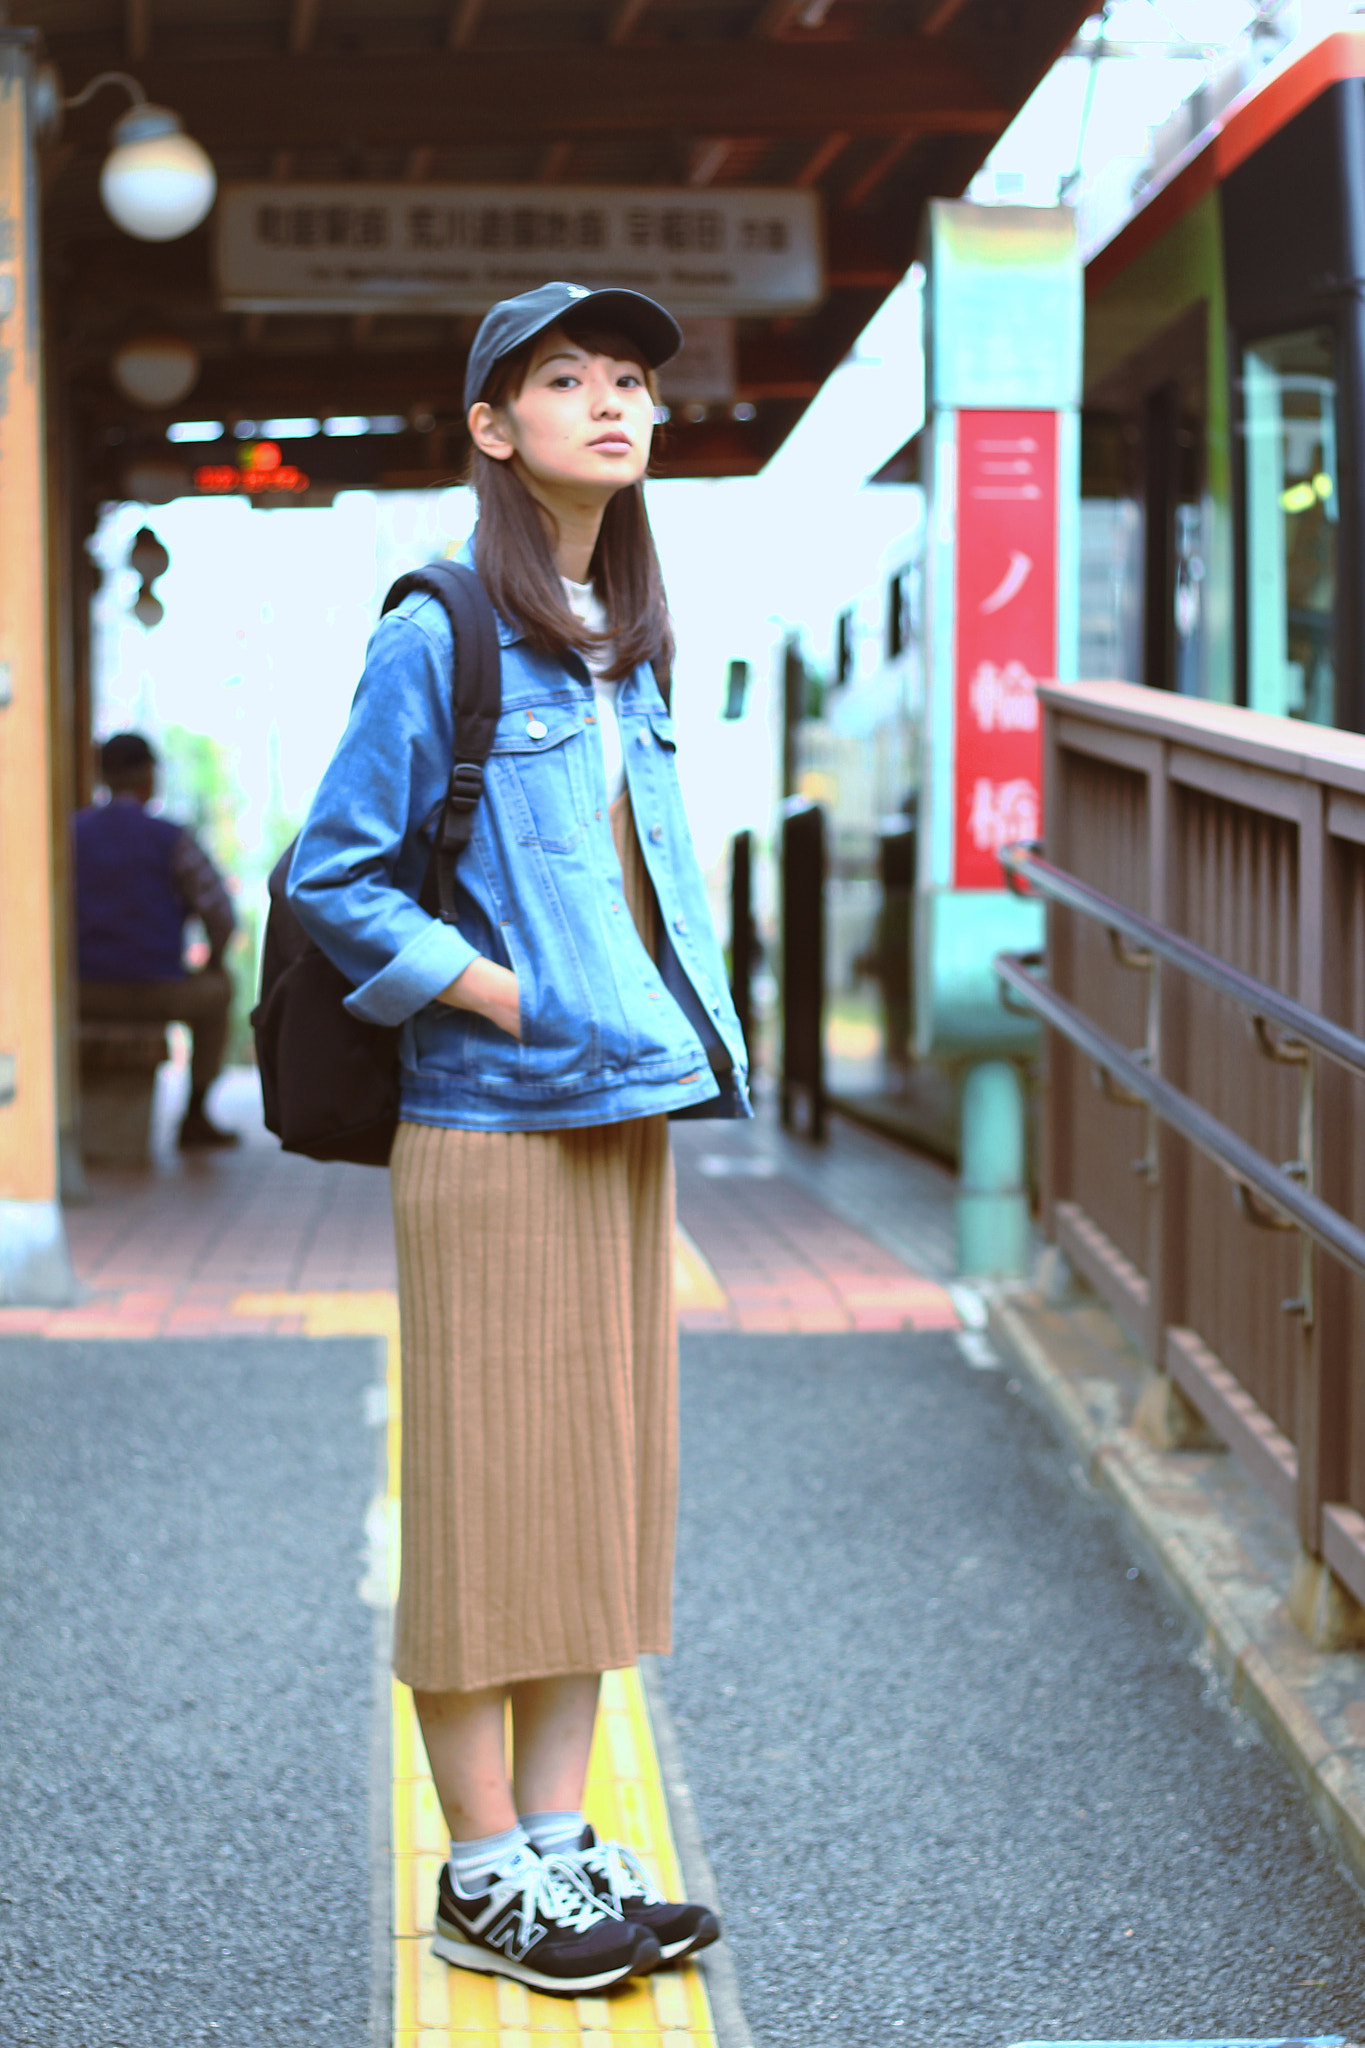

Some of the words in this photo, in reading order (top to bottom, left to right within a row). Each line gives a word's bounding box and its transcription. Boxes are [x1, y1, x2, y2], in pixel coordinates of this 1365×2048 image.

[969, 436, 1042, 851] 三ノ輪橋
[484, 1909, 548, 1962] N
